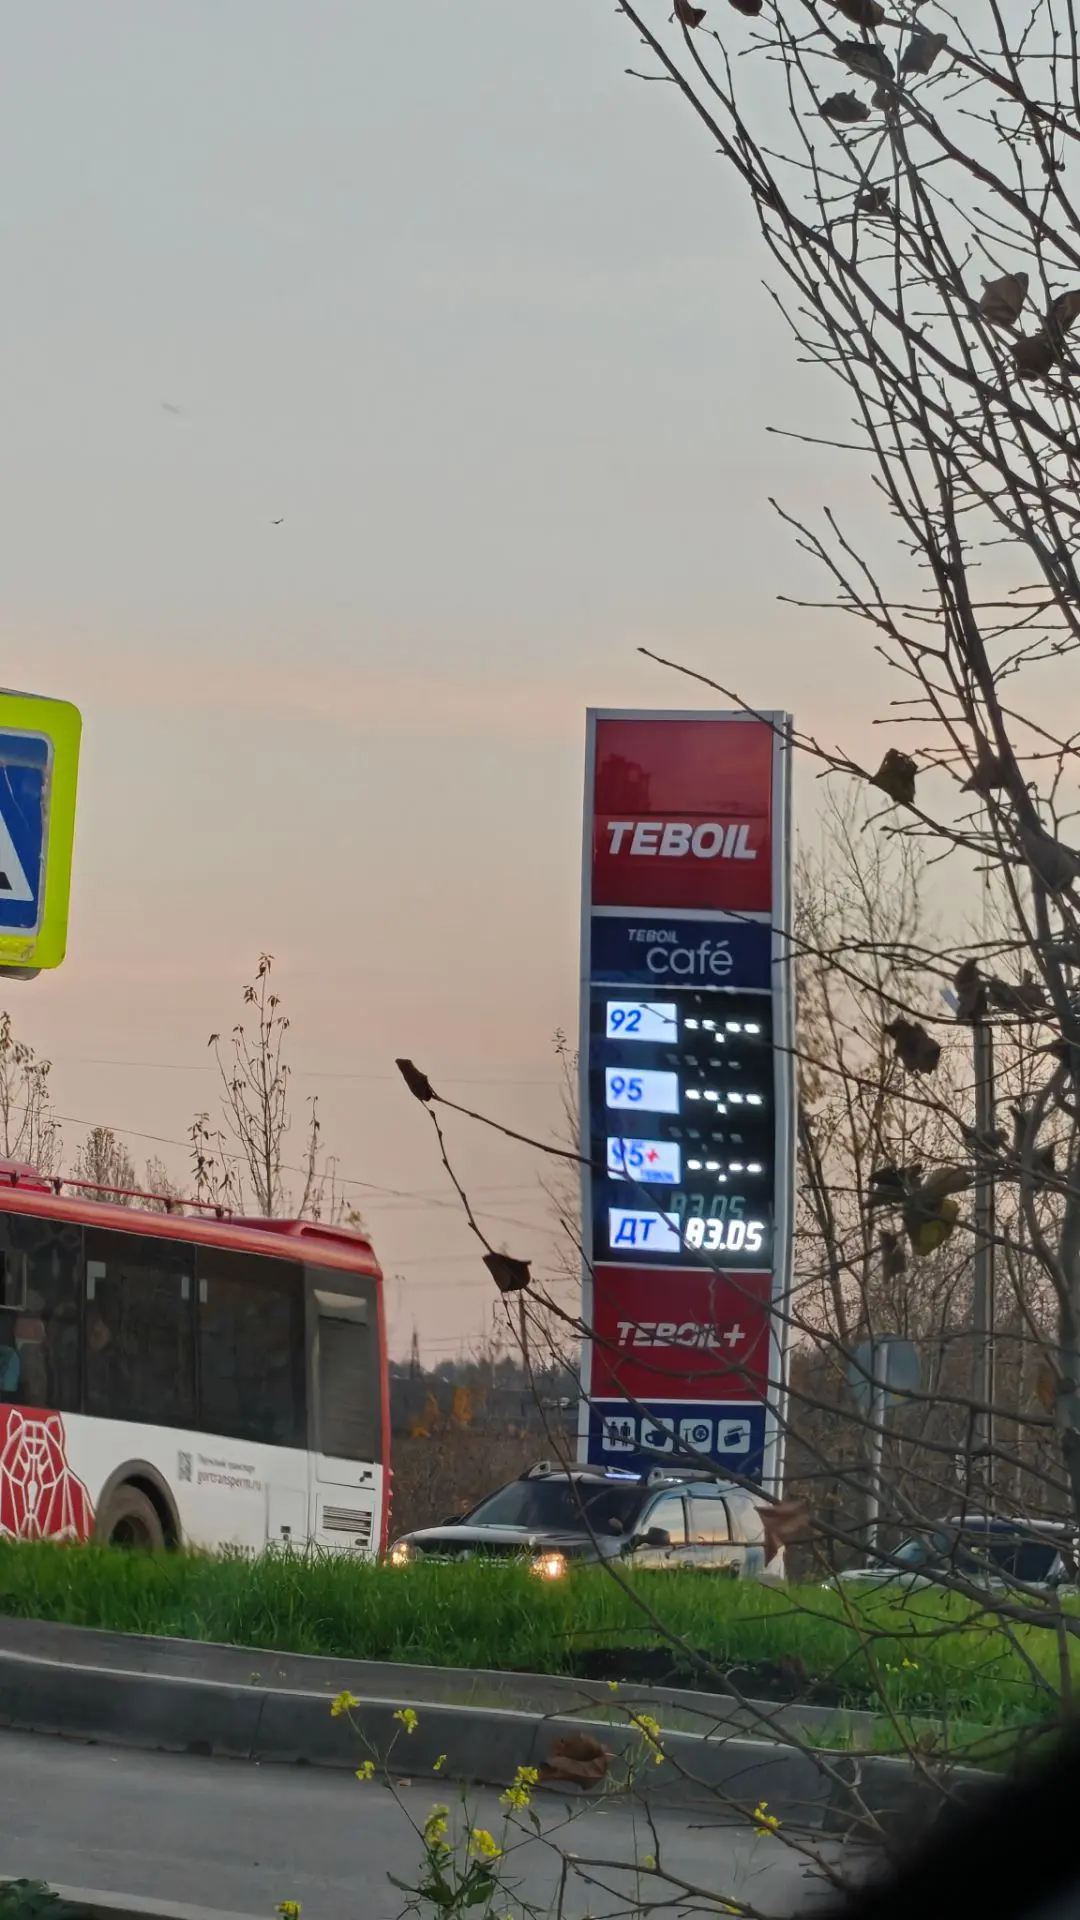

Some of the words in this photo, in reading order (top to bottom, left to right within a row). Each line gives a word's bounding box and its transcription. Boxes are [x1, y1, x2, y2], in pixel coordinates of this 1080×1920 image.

[607, 821, 757, 859] TEBOIL
[628, 929, 679, 943] TEBOIL
[646, 939, 733, 976] café
[610, 1009, 642, 1032] 92
[610, 1075, 643, 1102] 95
[614, 1217, 657, 1244] ДТ
[684, 1217, 765, 1251] 83.05
